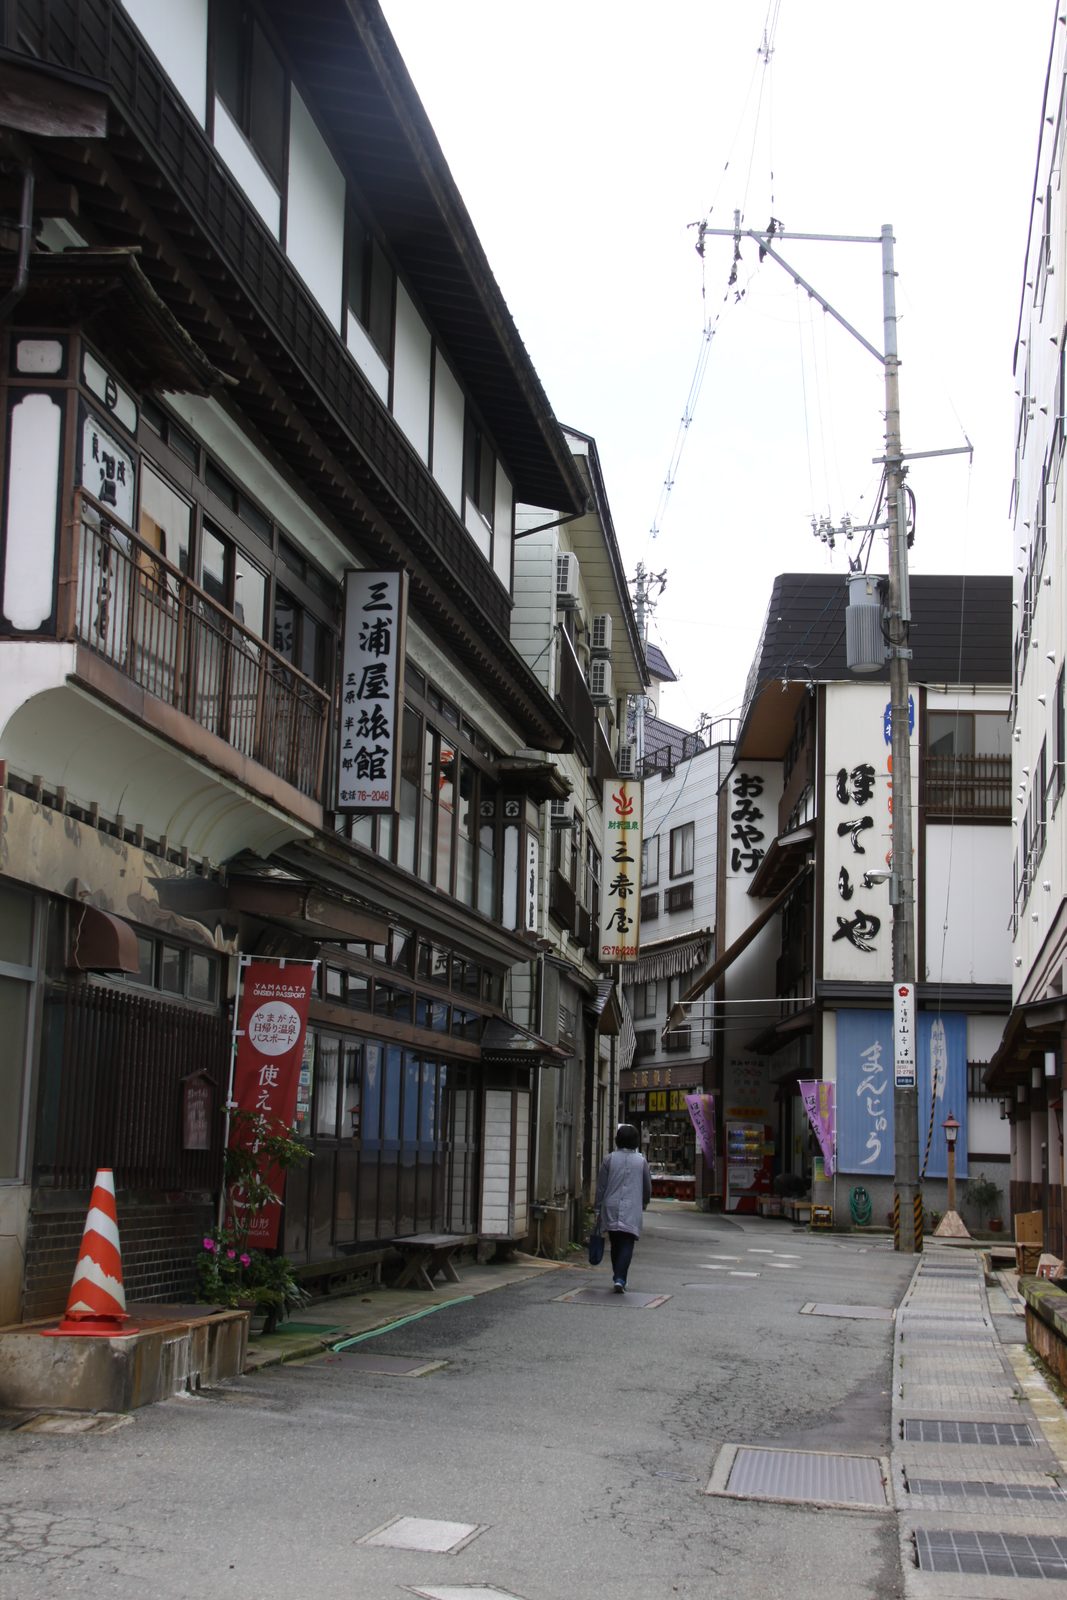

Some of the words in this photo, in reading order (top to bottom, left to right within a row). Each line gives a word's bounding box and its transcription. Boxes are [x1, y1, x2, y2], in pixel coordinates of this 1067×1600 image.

[354, 581, 393, 781] 三浦屋旅館
[730, 773, 765, 873] おみやげ
[832, 763, 881, 953] ほていや
[605, 841, 635, 933] 三春屋
[253, 989, 275, 997] ONSEN
[275, 990, 306, 999] PASSPORT
[254, 1023, 297, 1035] 日帰り温泉
[255, 983, 306, 992] YAMAGATA
[255, 1013, 298, 1024] やまがた
[857, 1040, 888, 1165] まんじゅう
